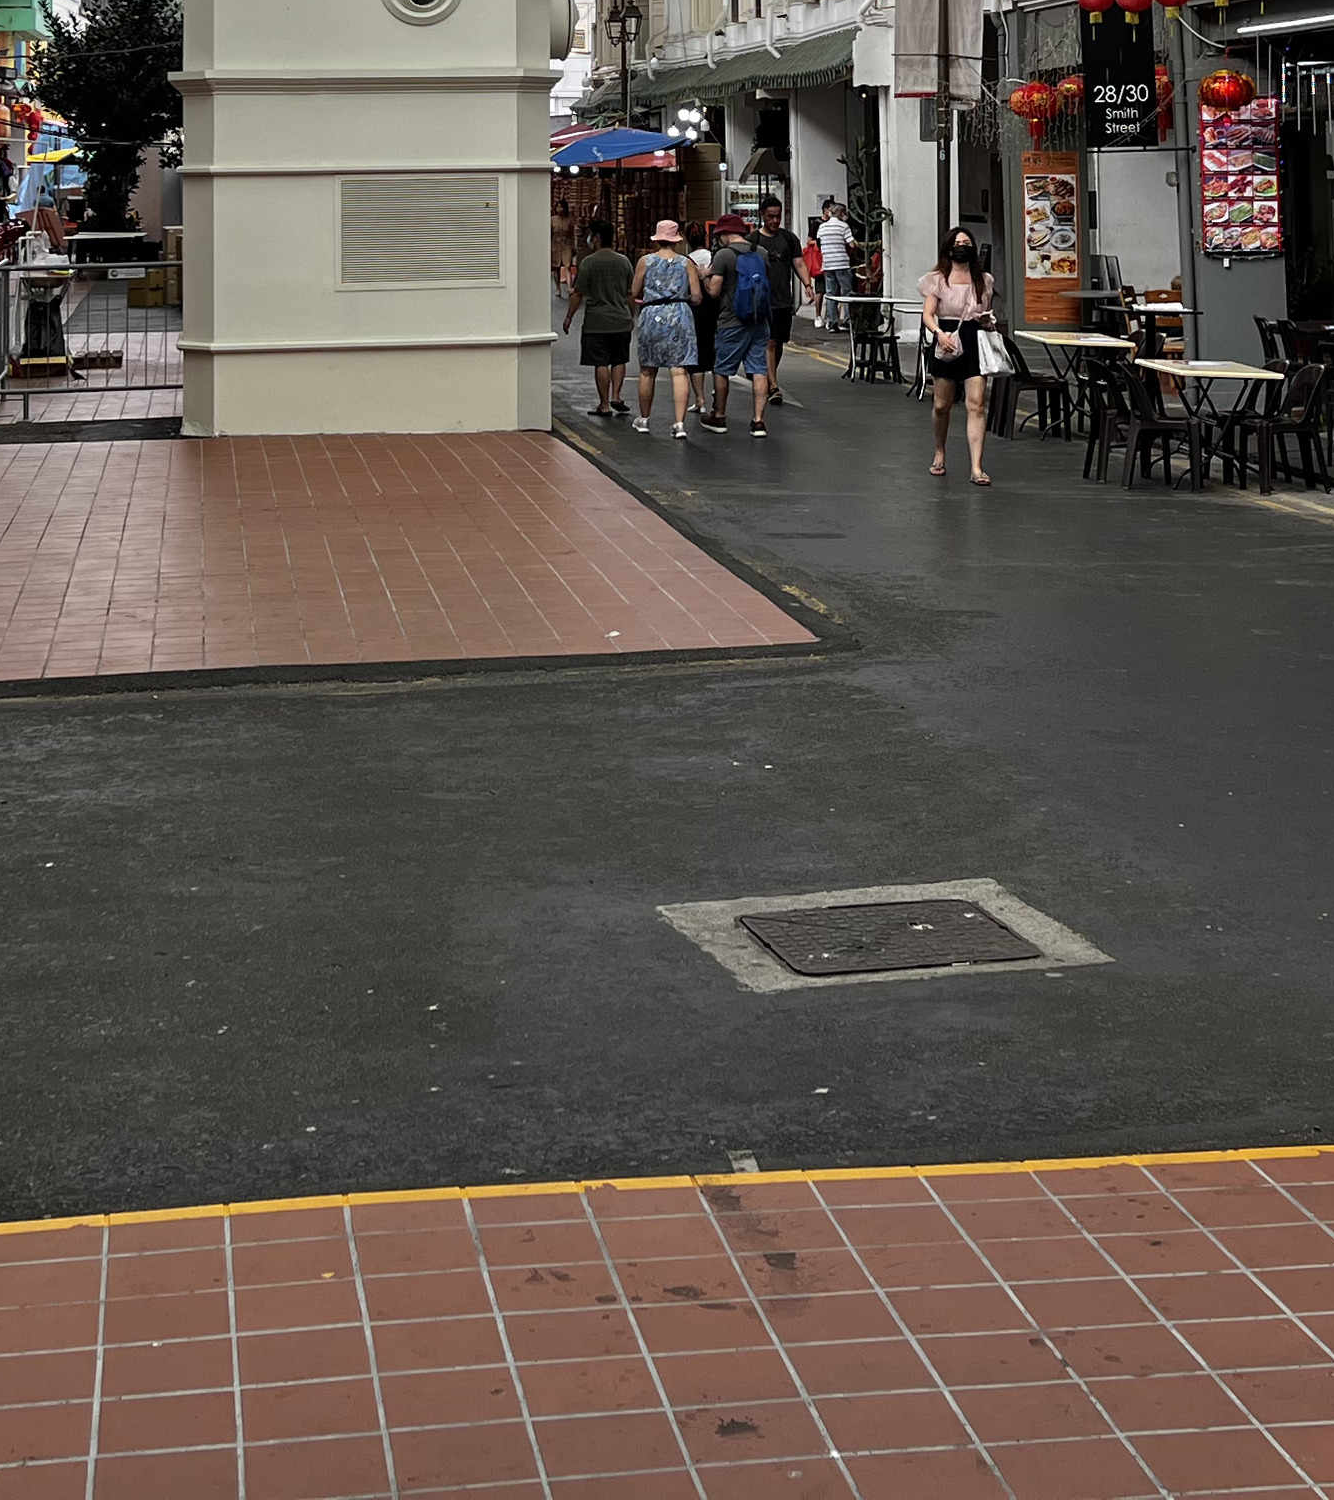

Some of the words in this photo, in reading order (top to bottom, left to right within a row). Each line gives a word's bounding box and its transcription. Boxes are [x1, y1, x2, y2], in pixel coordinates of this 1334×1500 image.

[1093, 84, 1149, 105] 28/30
[1105, 107, 1139, 119] Smith
[1105, 121, 1140, 134] Street
